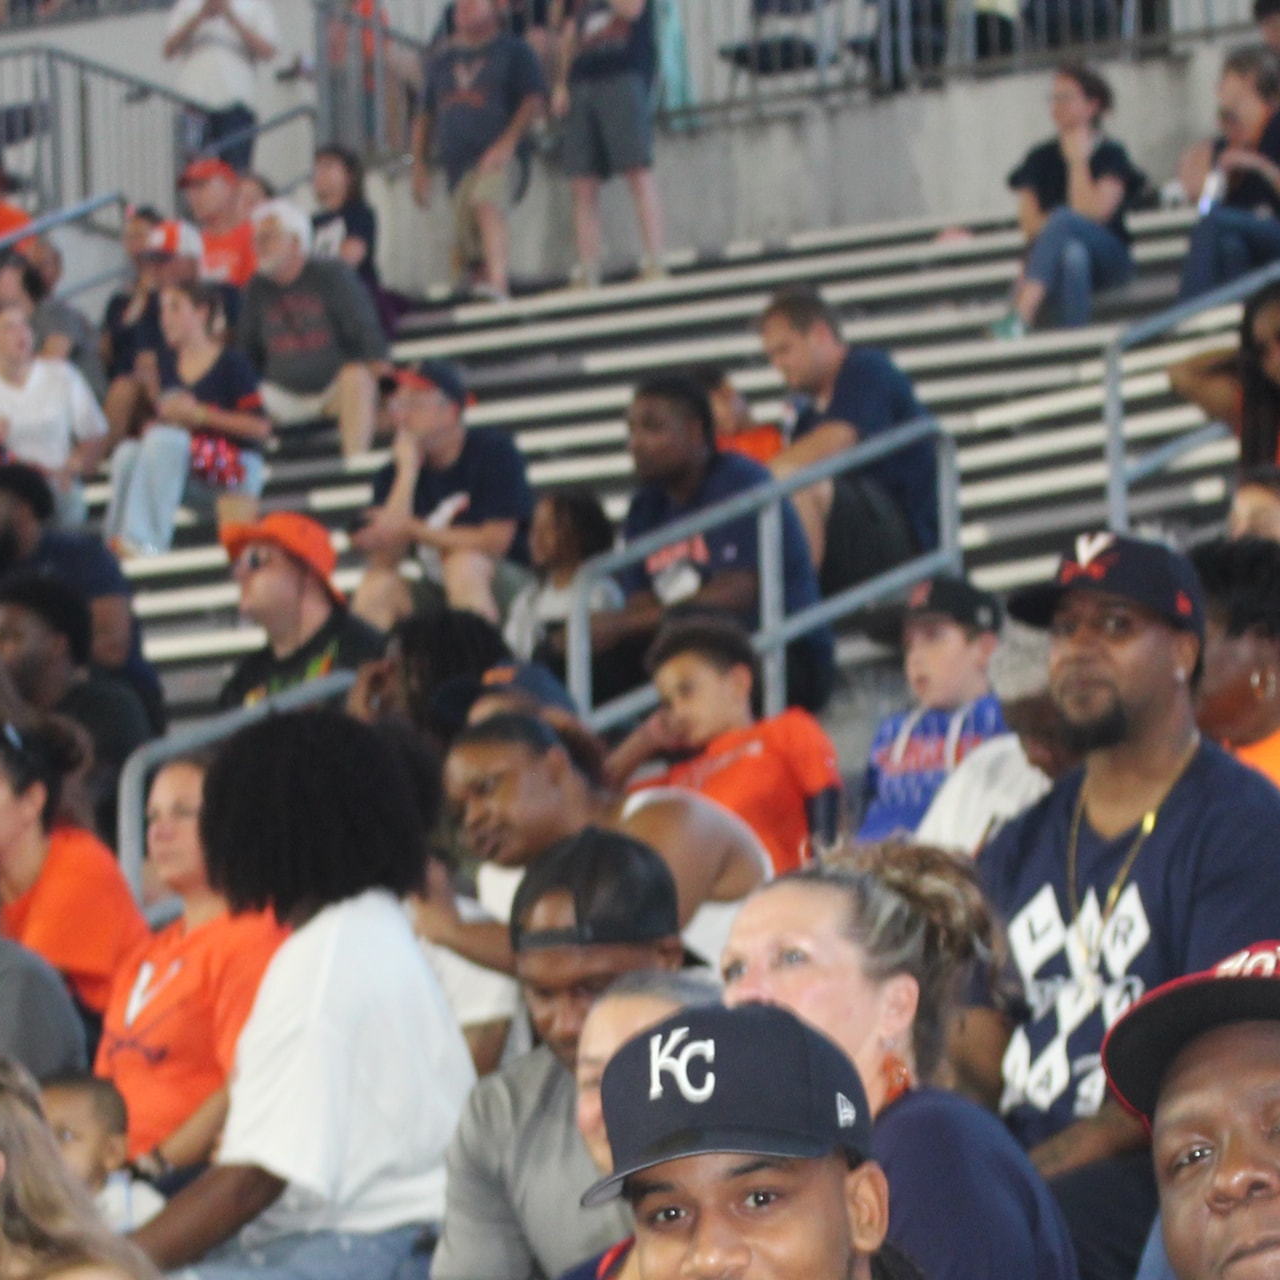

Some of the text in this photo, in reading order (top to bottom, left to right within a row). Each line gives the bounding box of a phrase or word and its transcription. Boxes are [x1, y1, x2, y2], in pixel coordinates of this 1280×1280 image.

[1075, 531, 1117, 570] V
[124, 959, 184, 1030] V
[649, 1026, 716, 1104] KC
